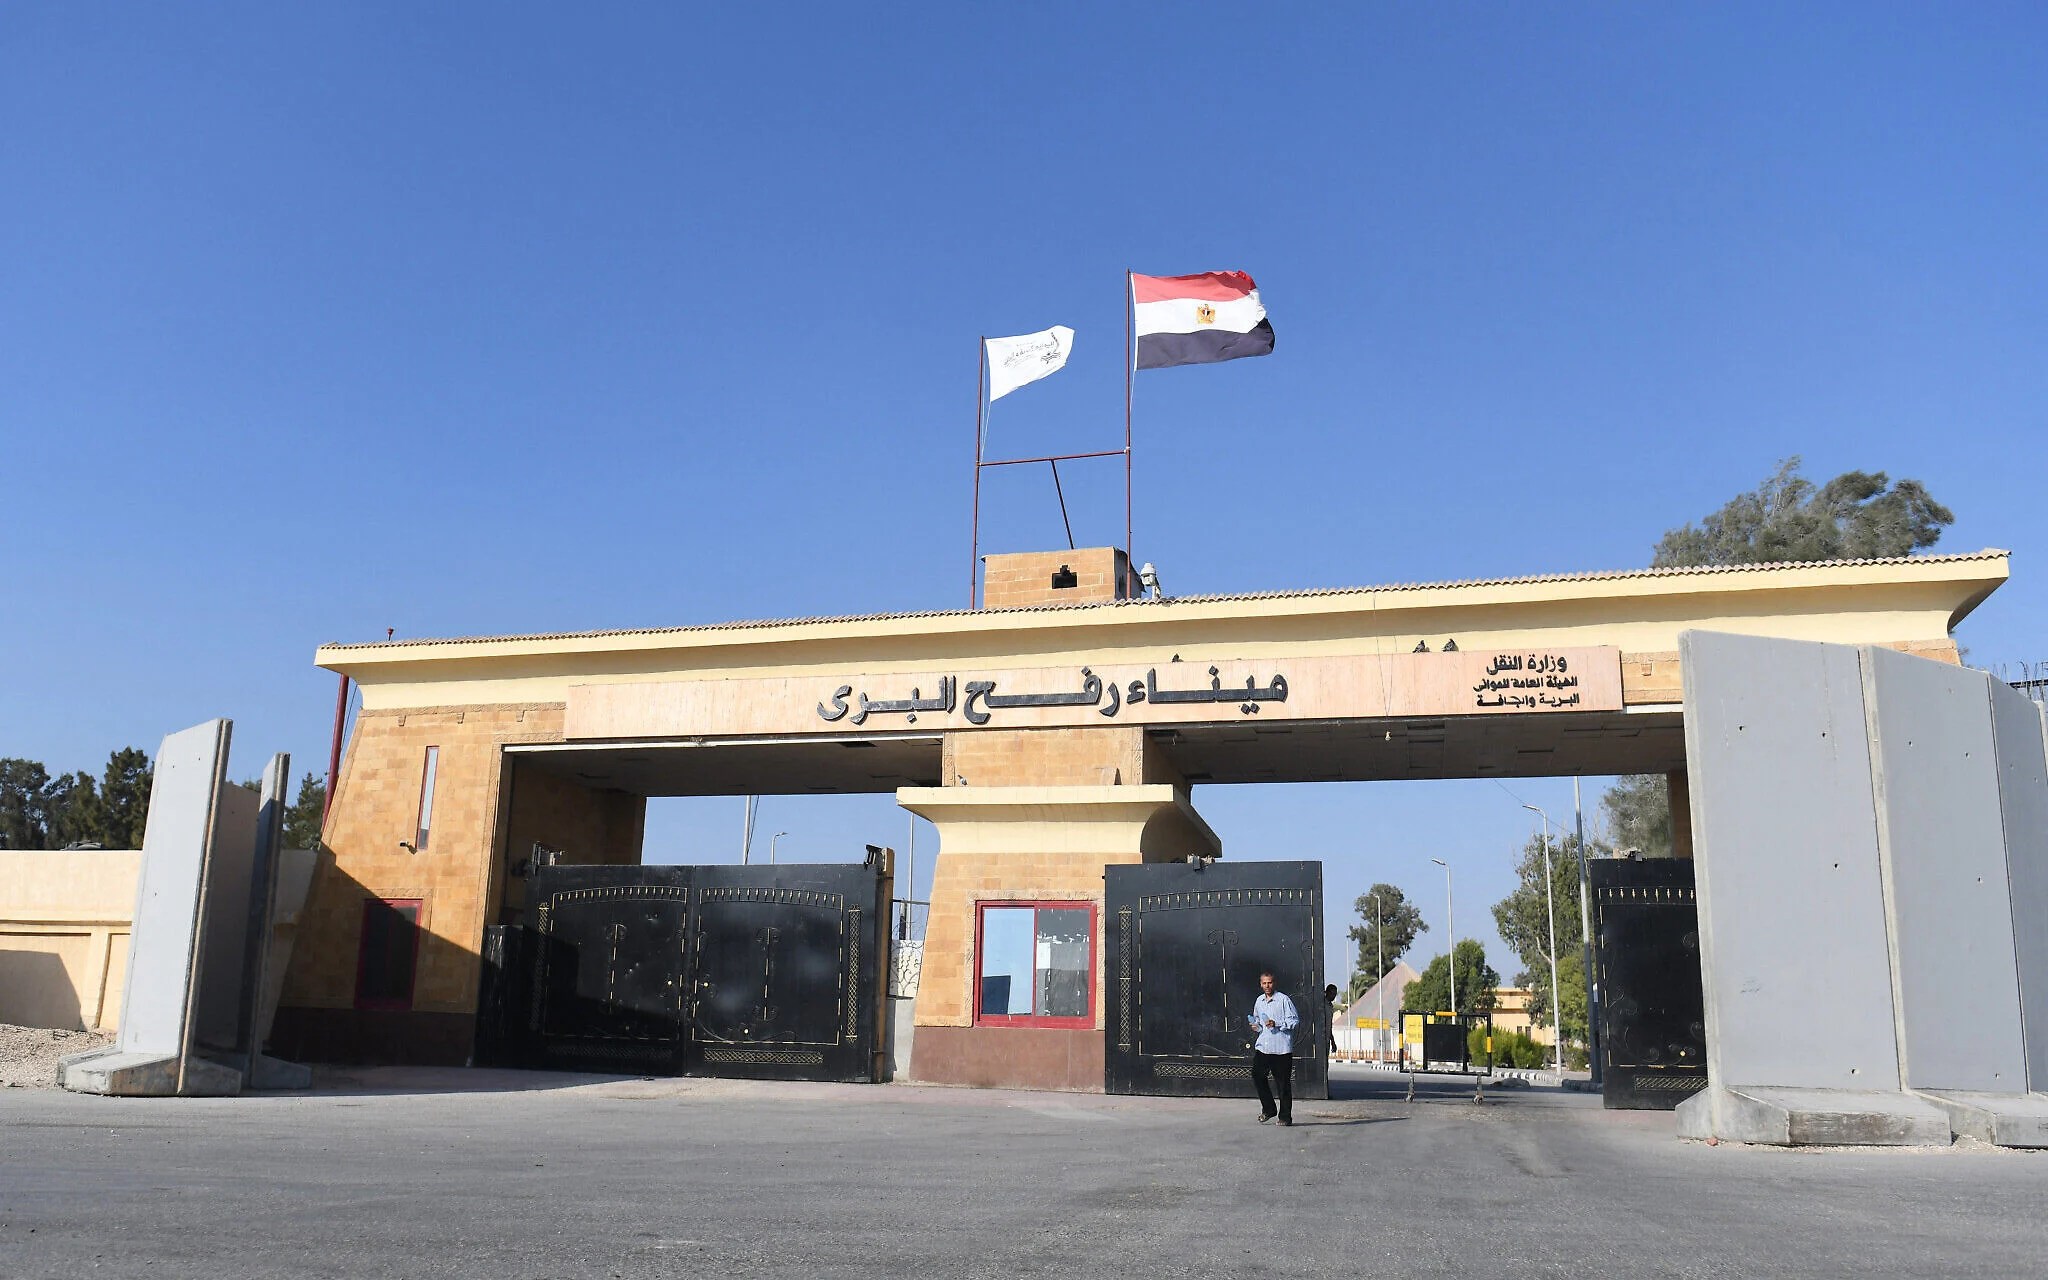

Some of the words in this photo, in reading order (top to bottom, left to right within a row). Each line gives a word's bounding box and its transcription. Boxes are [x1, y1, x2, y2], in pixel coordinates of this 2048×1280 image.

[1486, 654, 1523, 676] النقل
[1528, 654, 1568, 674] وزارة
[1126, 664, 1289, 715] ميناء
[1511, 677, 1544, 689] العامة
[1546, 675, 1578, 690] الهيئة
[963, 665, 1121, 725] رفح
[1476, 693, 1536, 709] والجافة
[1539, 692, 1580, 708] البرية
